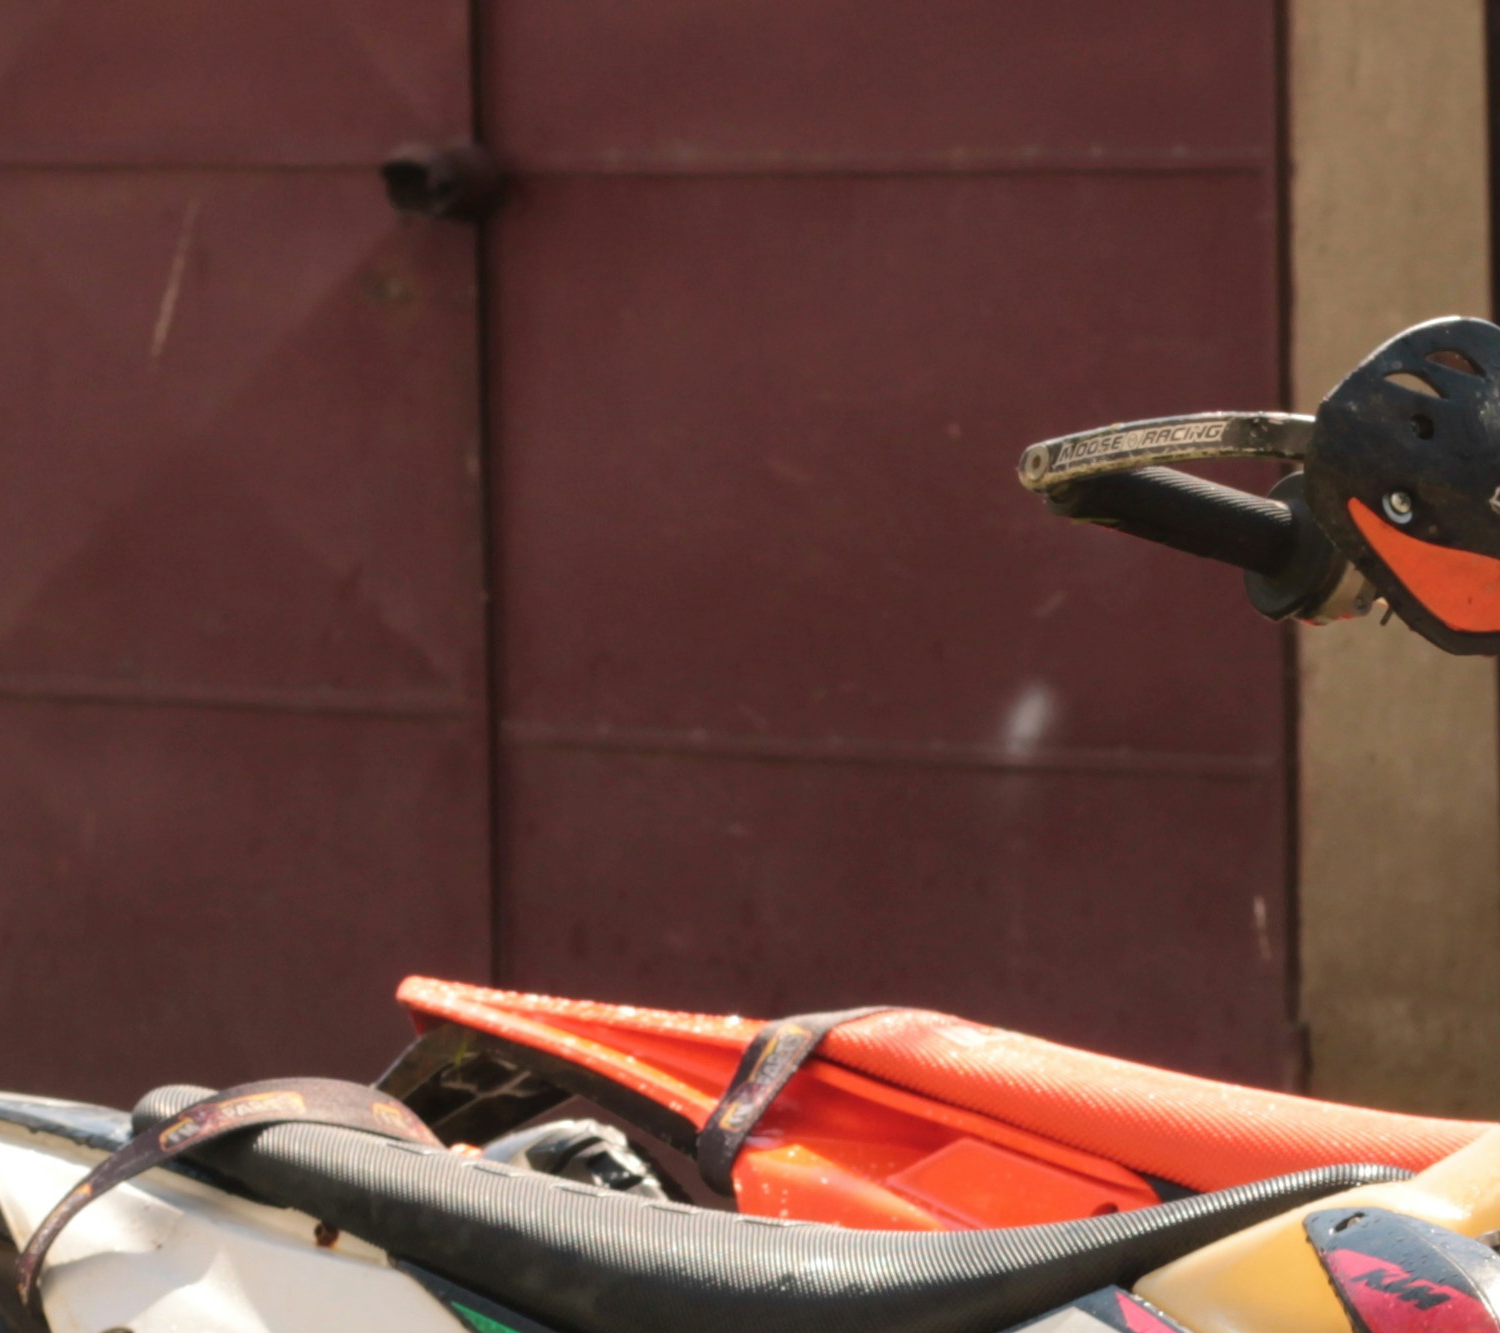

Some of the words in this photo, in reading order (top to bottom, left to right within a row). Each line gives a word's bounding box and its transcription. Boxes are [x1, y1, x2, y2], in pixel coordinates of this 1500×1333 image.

[1057, 434, 1123, 463] MOOSE
[1142, 424, 1222, 447] RACING
[1350, 1268, 1452, 1312] KTM
